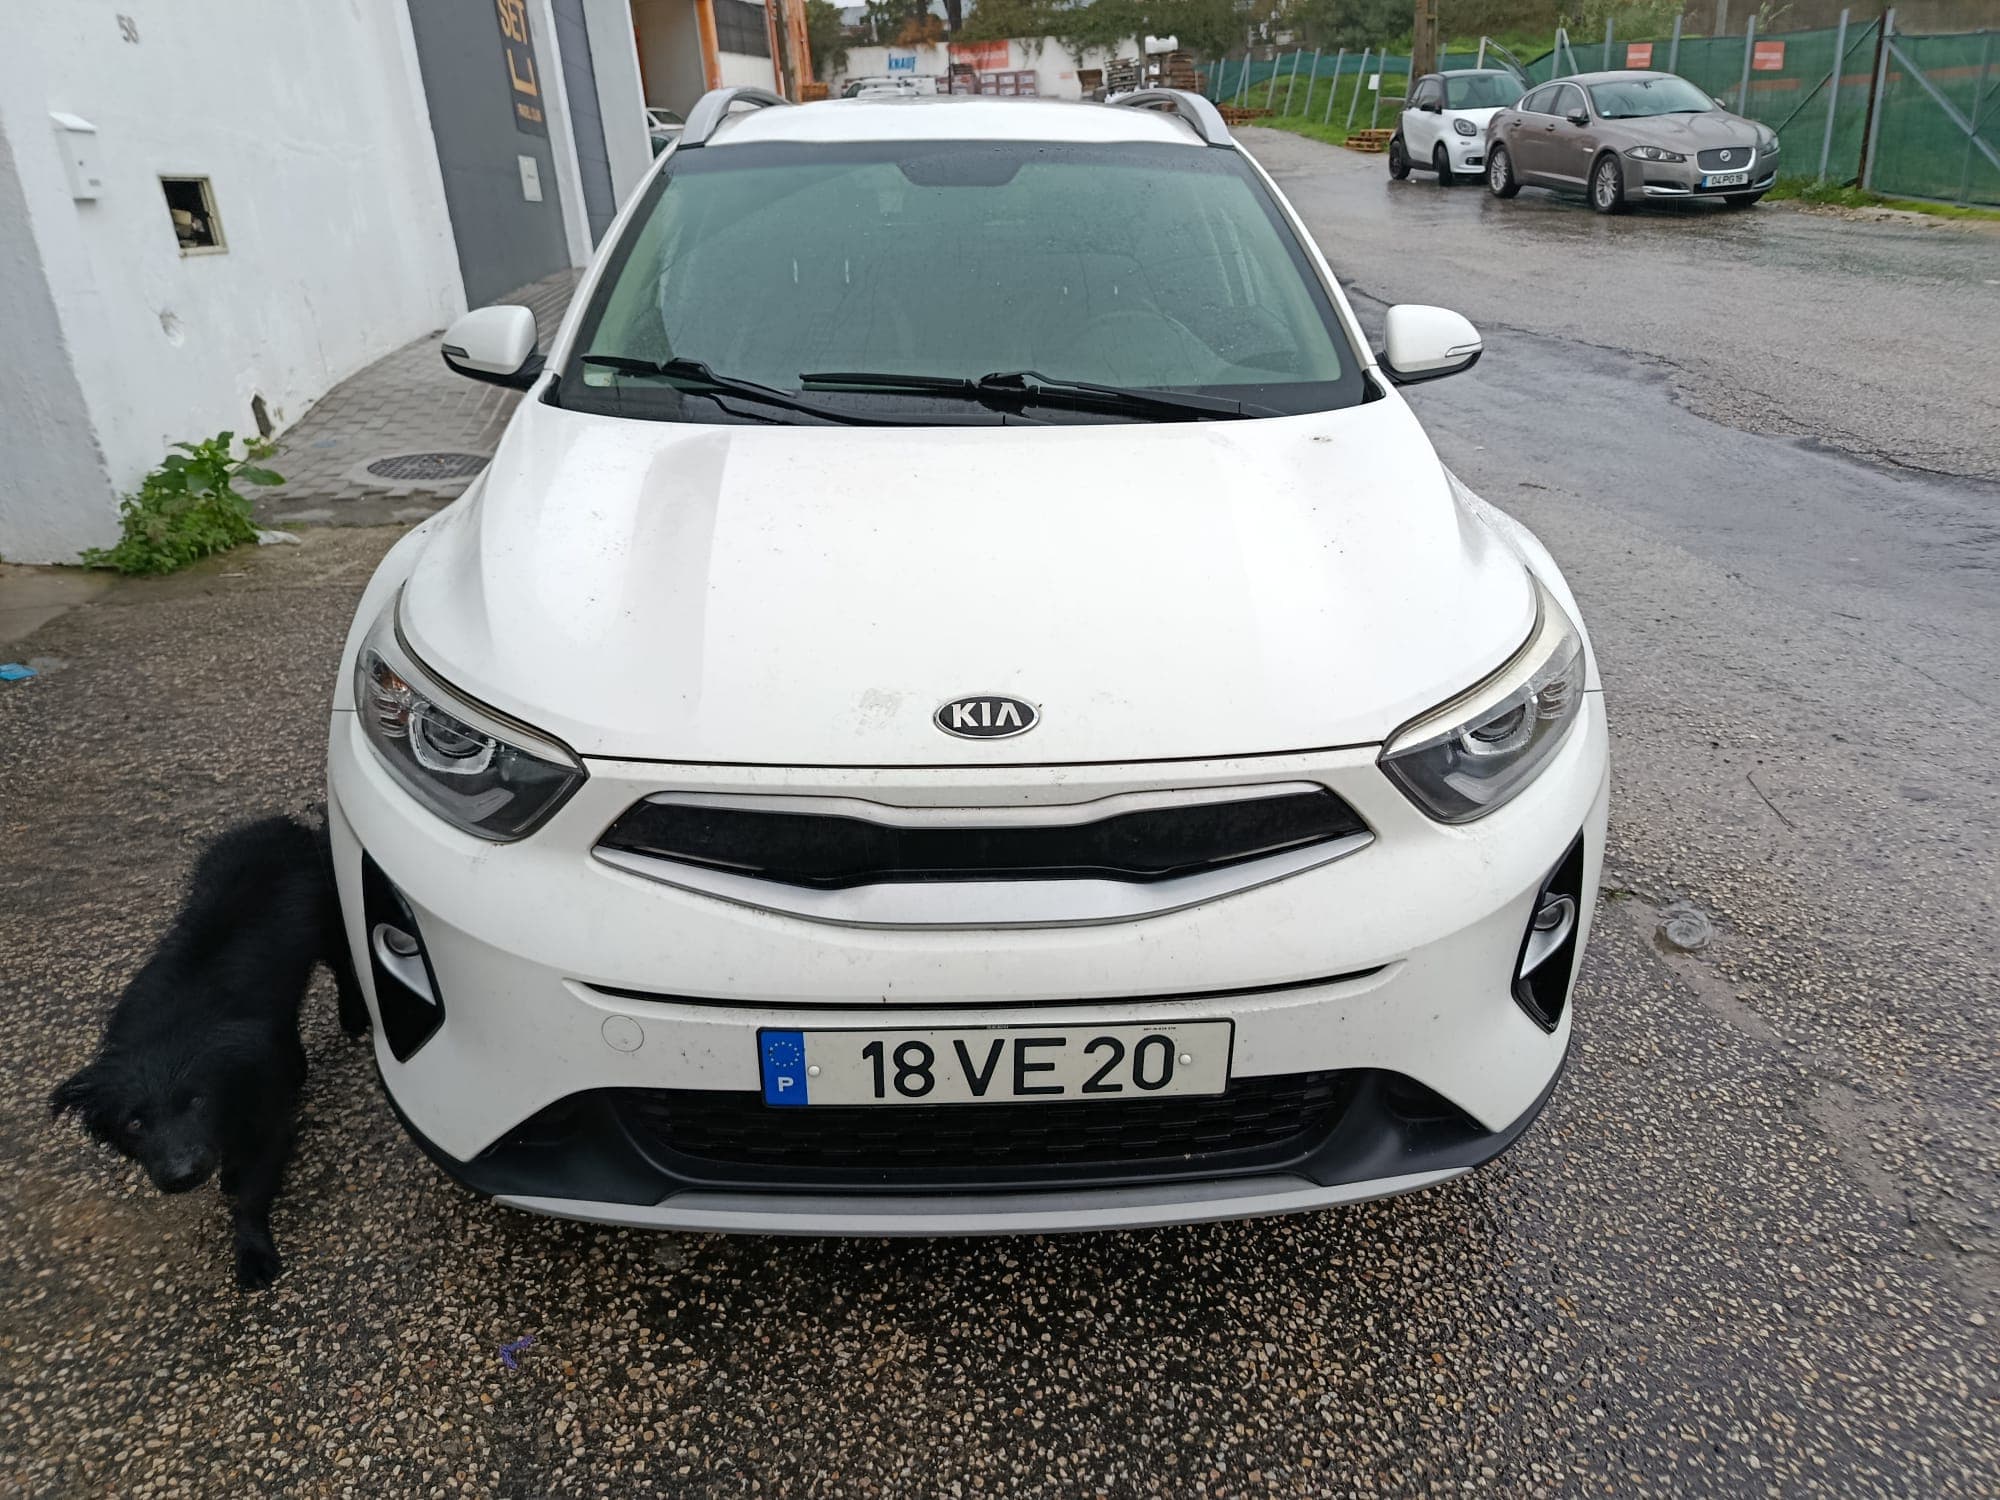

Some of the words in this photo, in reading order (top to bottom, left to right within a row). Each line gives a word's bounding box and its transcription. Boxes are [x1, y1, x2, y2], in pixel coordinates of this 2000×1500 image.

[1722, 174, 1735, 184] PG
[951, 701, 1023, 728] KIA
[861, 1040, 935, 1098] 18
[952, 1036, 1067, 1097] VE
[1081, 1034, 1175, 1094] 20
[777, 1076, 794, 1092] P
